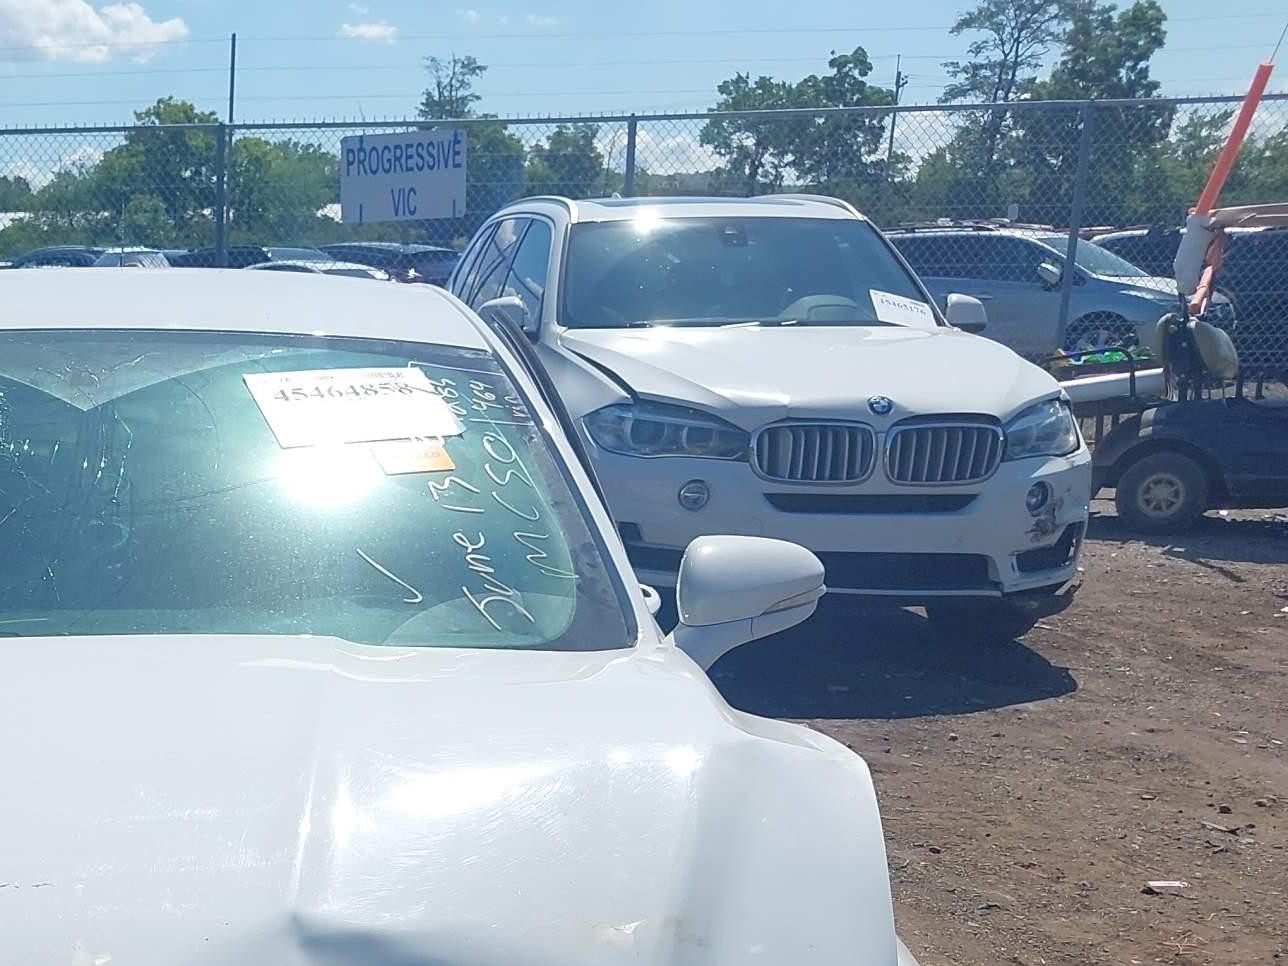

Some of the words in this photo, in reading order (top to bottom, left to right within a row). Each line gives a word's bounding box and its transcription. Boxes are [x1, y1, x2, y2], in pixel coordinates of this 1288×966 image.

[345, 139, 462, 177] PROGRESSIVE
[391, 186, 418, 217] VIC
[273, 381, 415, 402] 45464858
[427, 476, 482, 513] 13
[452, 530, 536, 631] June
